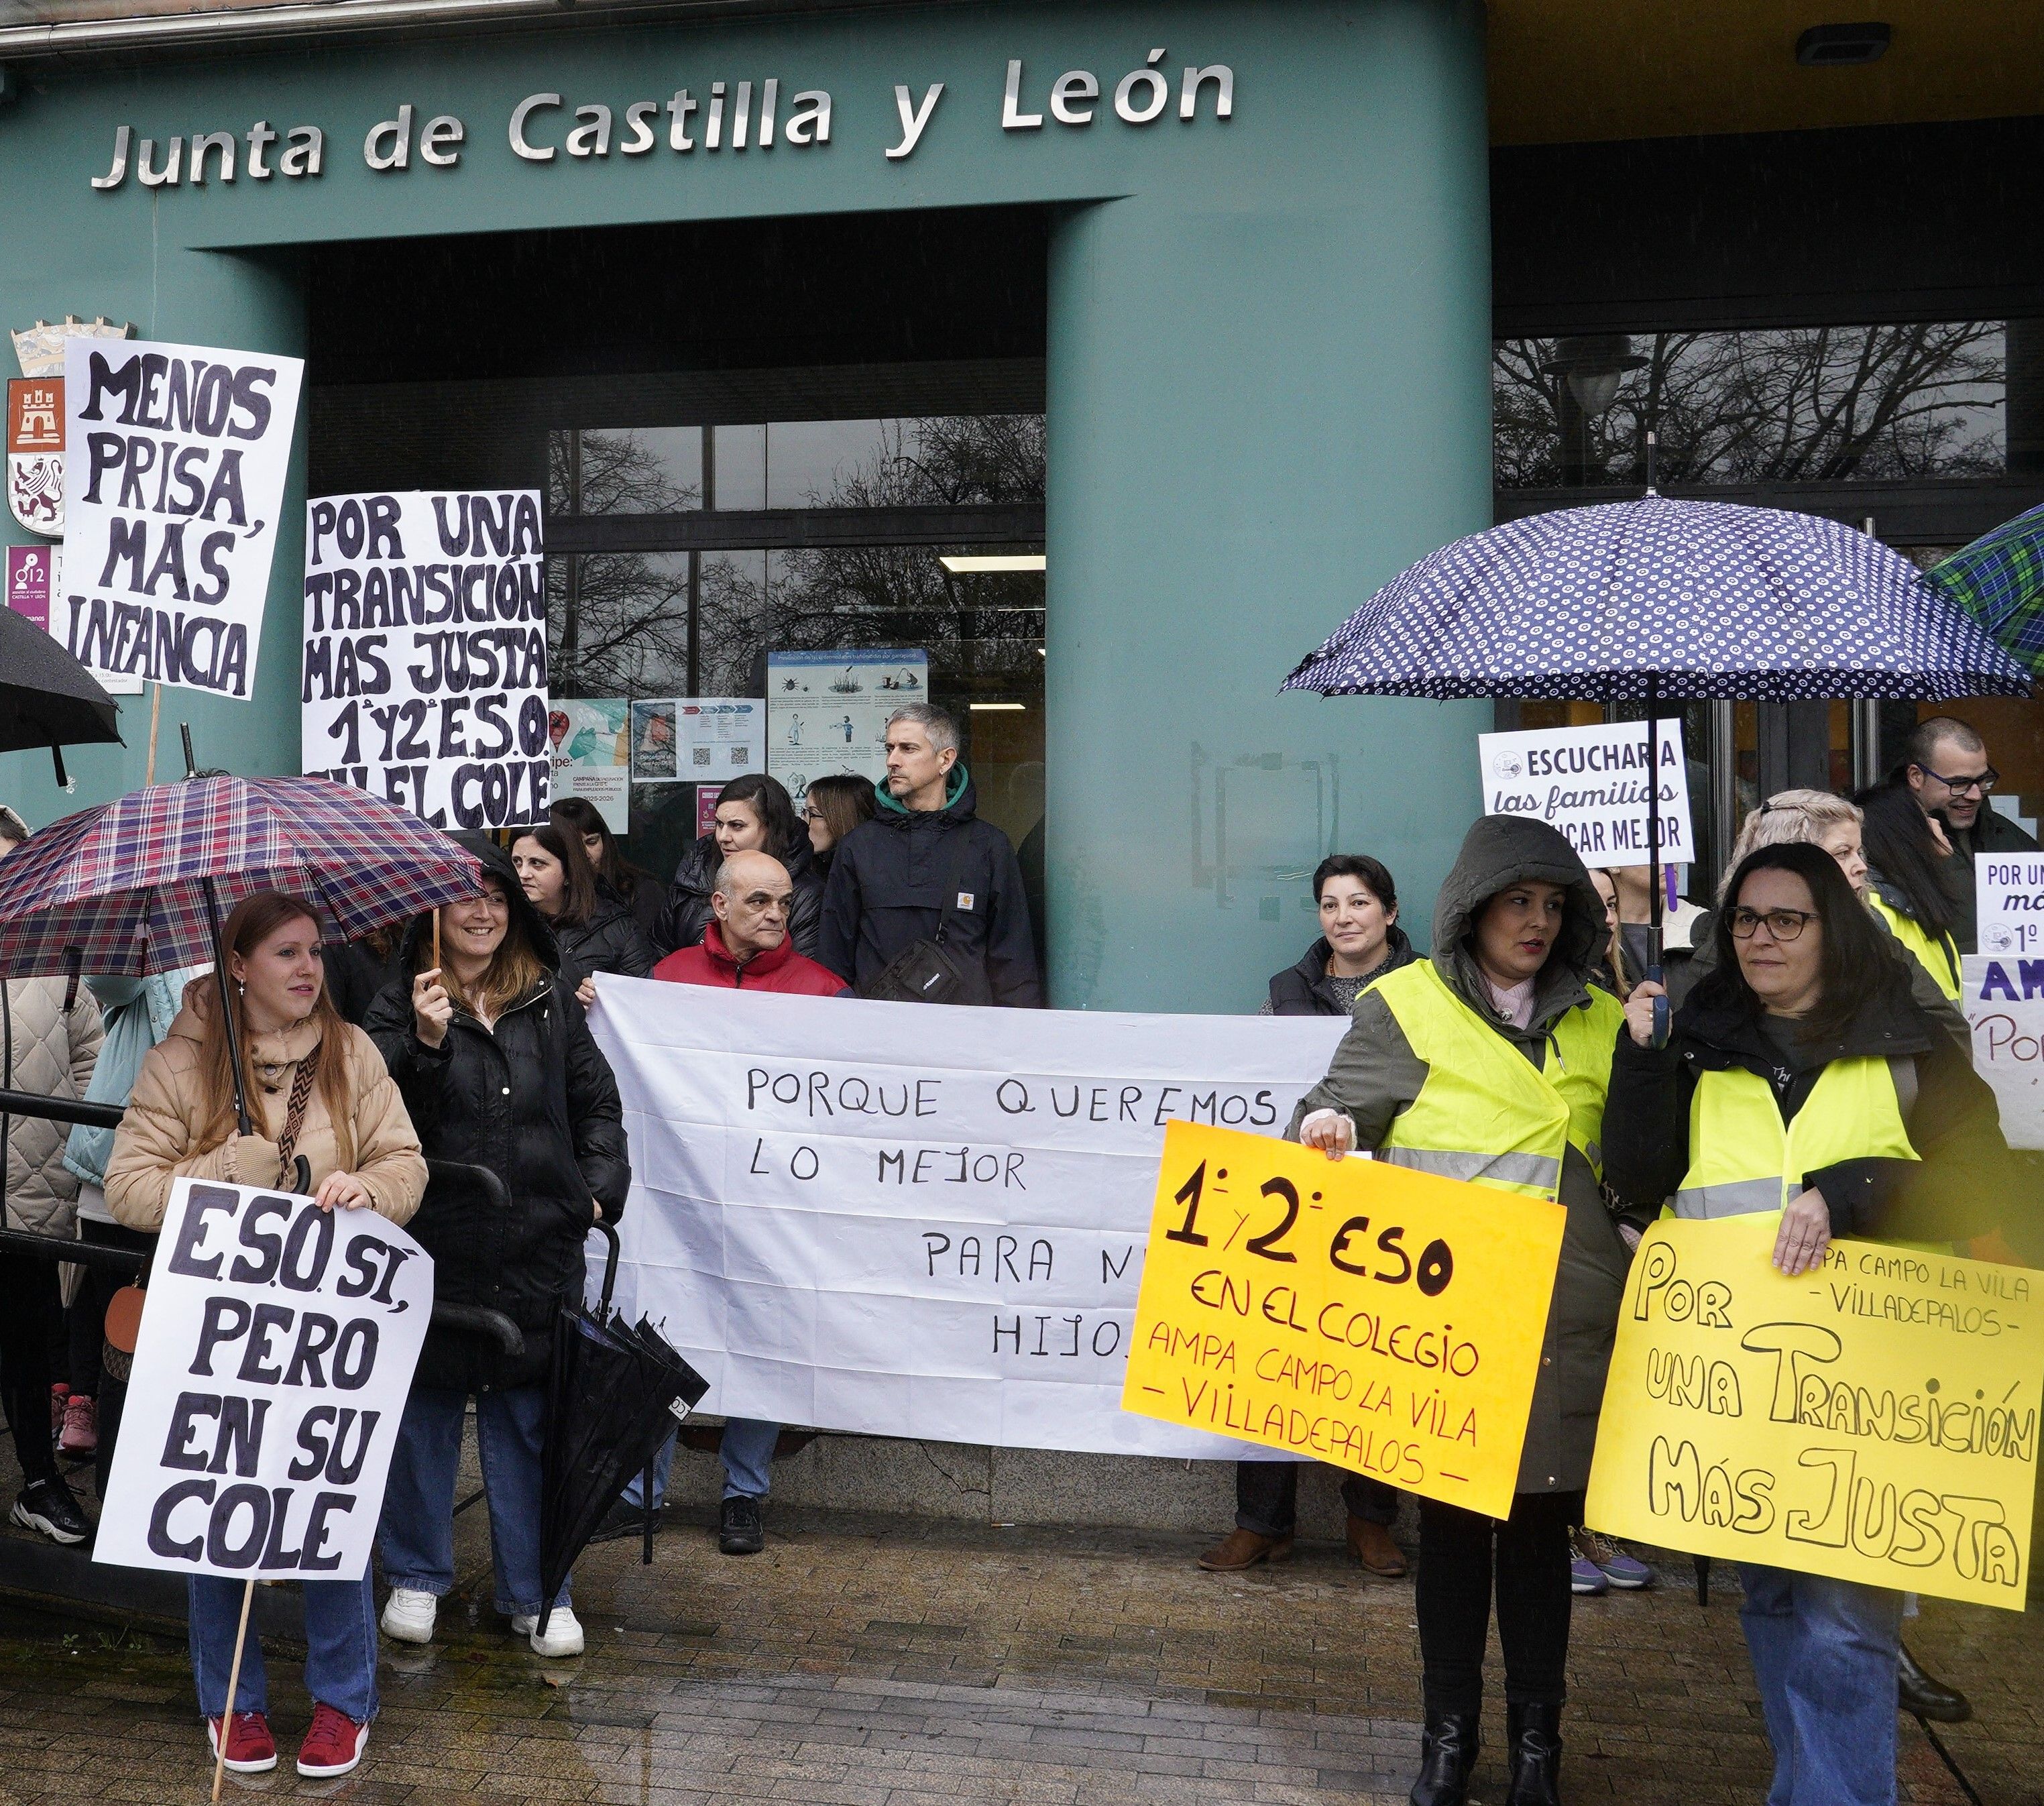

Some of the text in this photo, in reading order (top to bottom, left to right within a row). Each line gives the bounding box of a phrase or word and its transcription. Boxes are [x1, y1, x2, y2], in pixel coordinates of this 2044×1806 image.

[91, 49, 1236, 191] Junta de Castilla y León
[78, 351, 276, 441] MENOS
[82, 432, 265, 539] PRISA,
[98, 516, 235, 605] MÁS
[312, 494, 543, 565] POR UNA
[305, 555, 545, 632] TRANSICIÓN
[68, 595, 247, 697] INFANCIA
[302, 627, 548, 703] MAS JUSTA
[437, 693, 549, 759] E.S.O.
[1528, 742, 1650, 777] ESCUCHAR
[1661, 740, 1677, 767] A
[383, 760, 551, 829] EL COLE
[1493, 791, 1542, 813] las
[1612, 817, 1681, 851] MEJOR
[1988, 864, 2021, 885] POR
[2014, 924, 2037, 952] 1º
[748, 1068, 1277, 1126] PORQUE QUEREMOS
[750, 1137, 1027, 1190] LO MEJOR
[168, 1184, 419, 1313] E.S.O. SÍ,
[922, 1231, 1054, 1284] PARA
[1329, 1215, 1454, 1297] ESO
[1859, 1253, 1930, 1284] CAMPO
[1940, 1262, 1967, 1290] LA
[188, 1296, 379, 1390] PERO
[993, 1314, 1128, 1360] HIJO
[1191, 1269, 1479, 1377] EN EL COLEGIO
[1148, 1321, 1236, 1374] AMPA
[1255, 1348, 1353, 1400] CAMPO
[1359, 1379, 1393, 1416] LA
[1646, 1321, 2035, 1462] UNA TRANSICIÓN
[160, 1392, 381, 1484] EN SU
[147, 1479, 357, 1571] COLE
[1648, 1435, 2020, 1587] MÁS JUSTA
